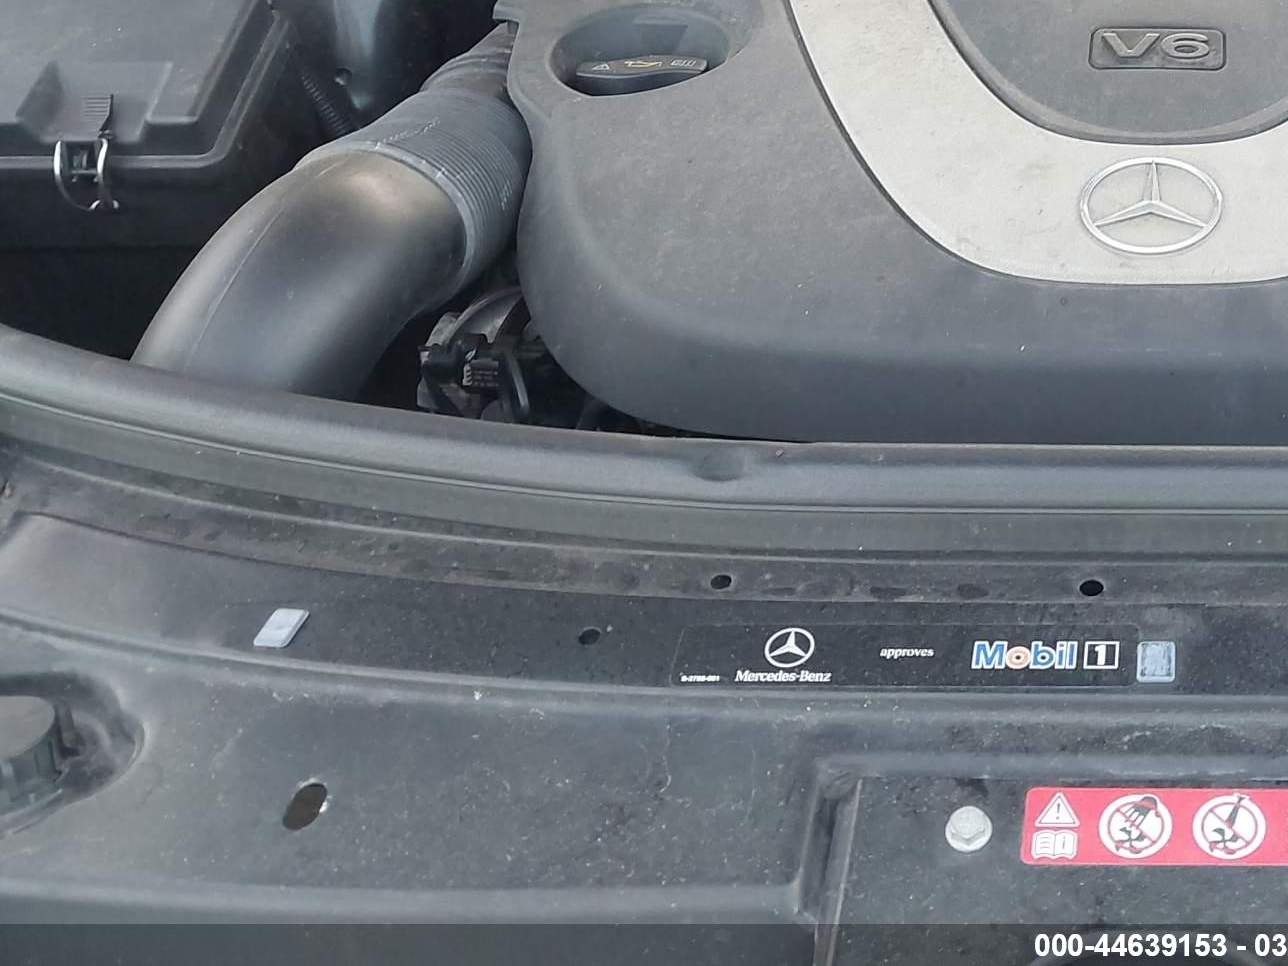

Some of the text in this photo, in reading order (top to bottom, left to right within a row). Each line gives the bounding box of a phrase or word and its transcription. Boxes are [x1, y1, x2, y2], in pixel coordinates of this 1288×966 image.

[1102, 32, 1210, 60] V6
[880, 647, 934, 659] approves
[971, 641, 1078, 669] Mobil
[735, 670, 832, 682] Mercedes-Benz
